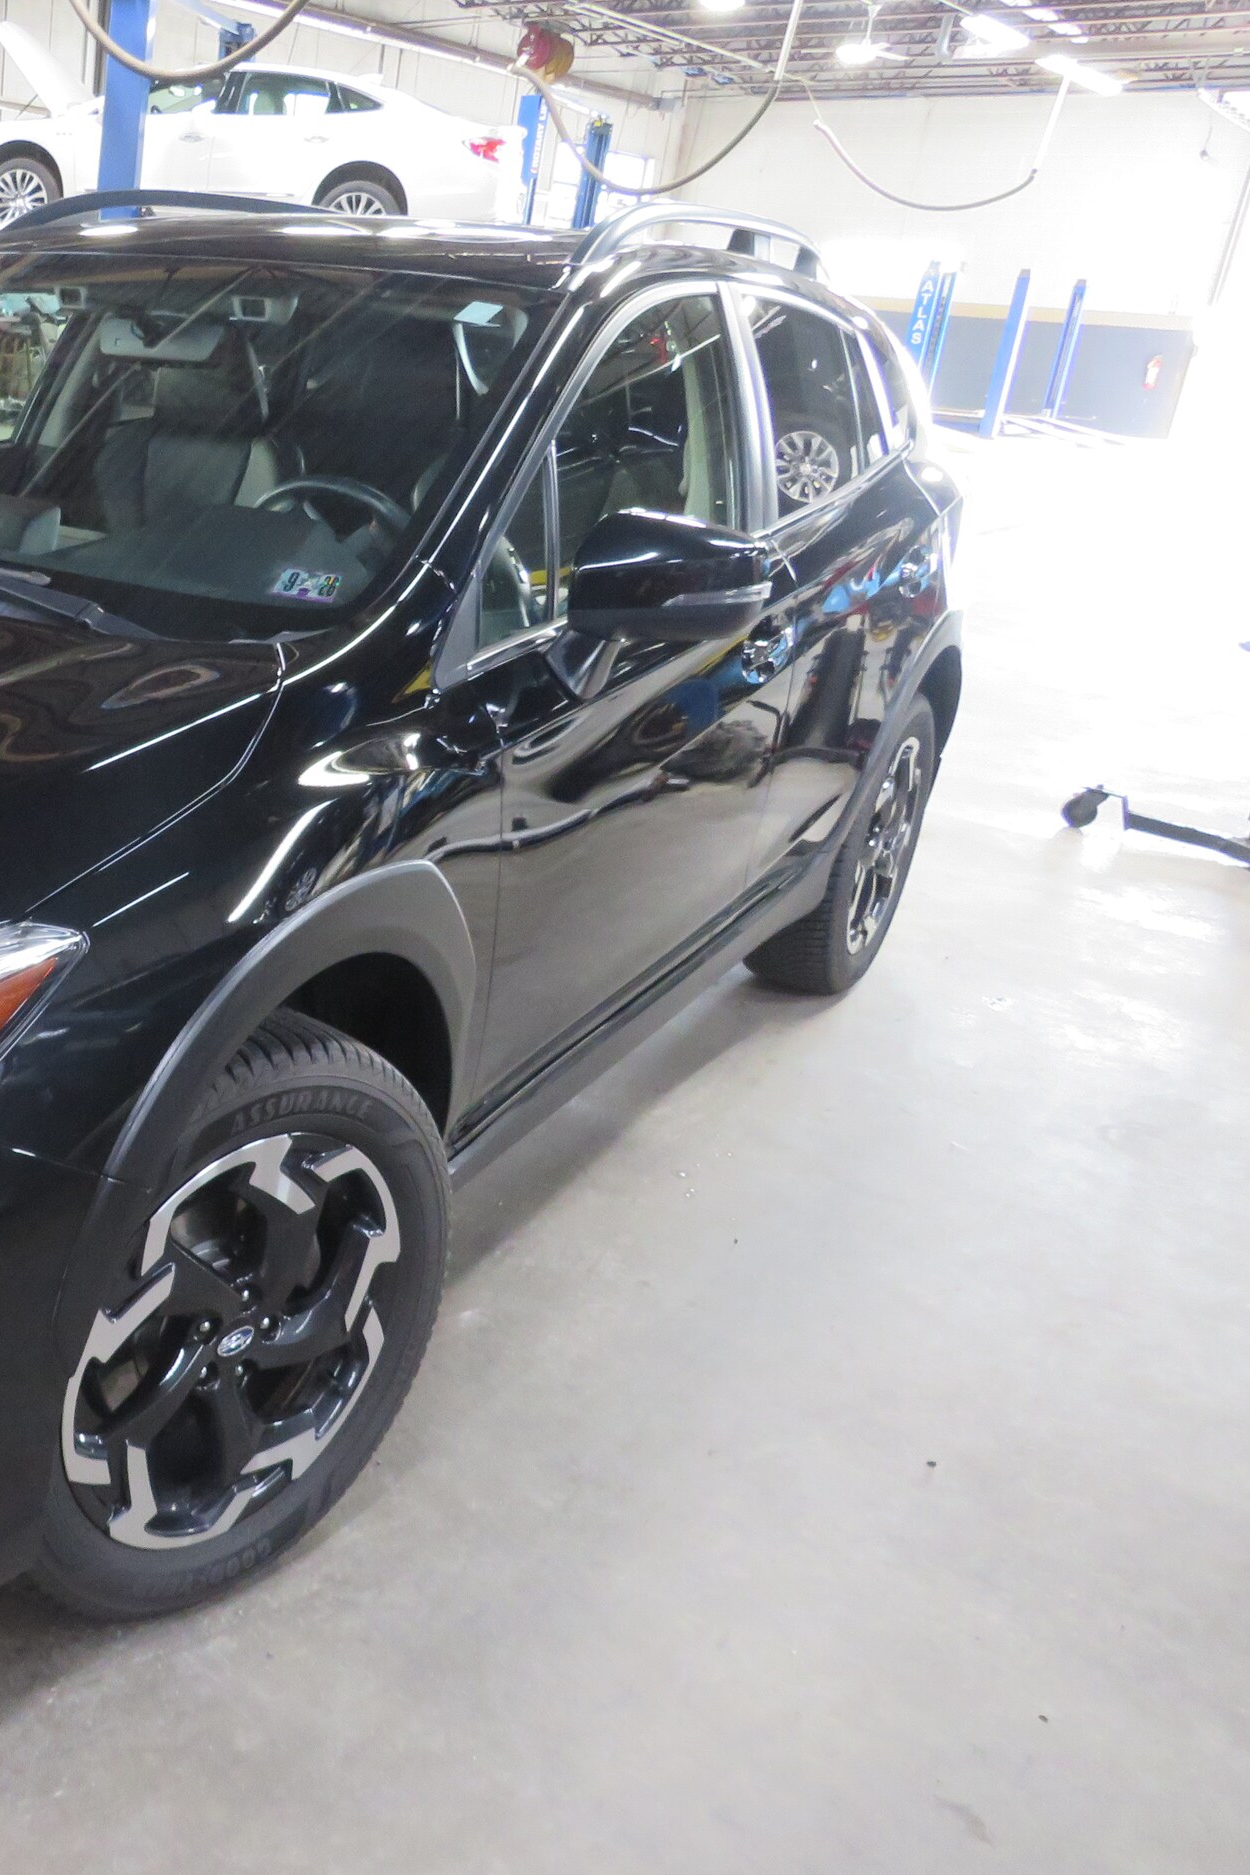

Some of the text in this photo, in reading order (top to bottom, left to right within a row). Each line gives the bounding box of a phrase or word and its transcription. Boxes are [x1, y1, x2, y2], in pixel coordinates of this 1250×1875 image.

[911, 280, 934, 344] ATLAS
[282, 571, 301, 592] 9
[231, 1089, 374, 1136] ASSURANCE
